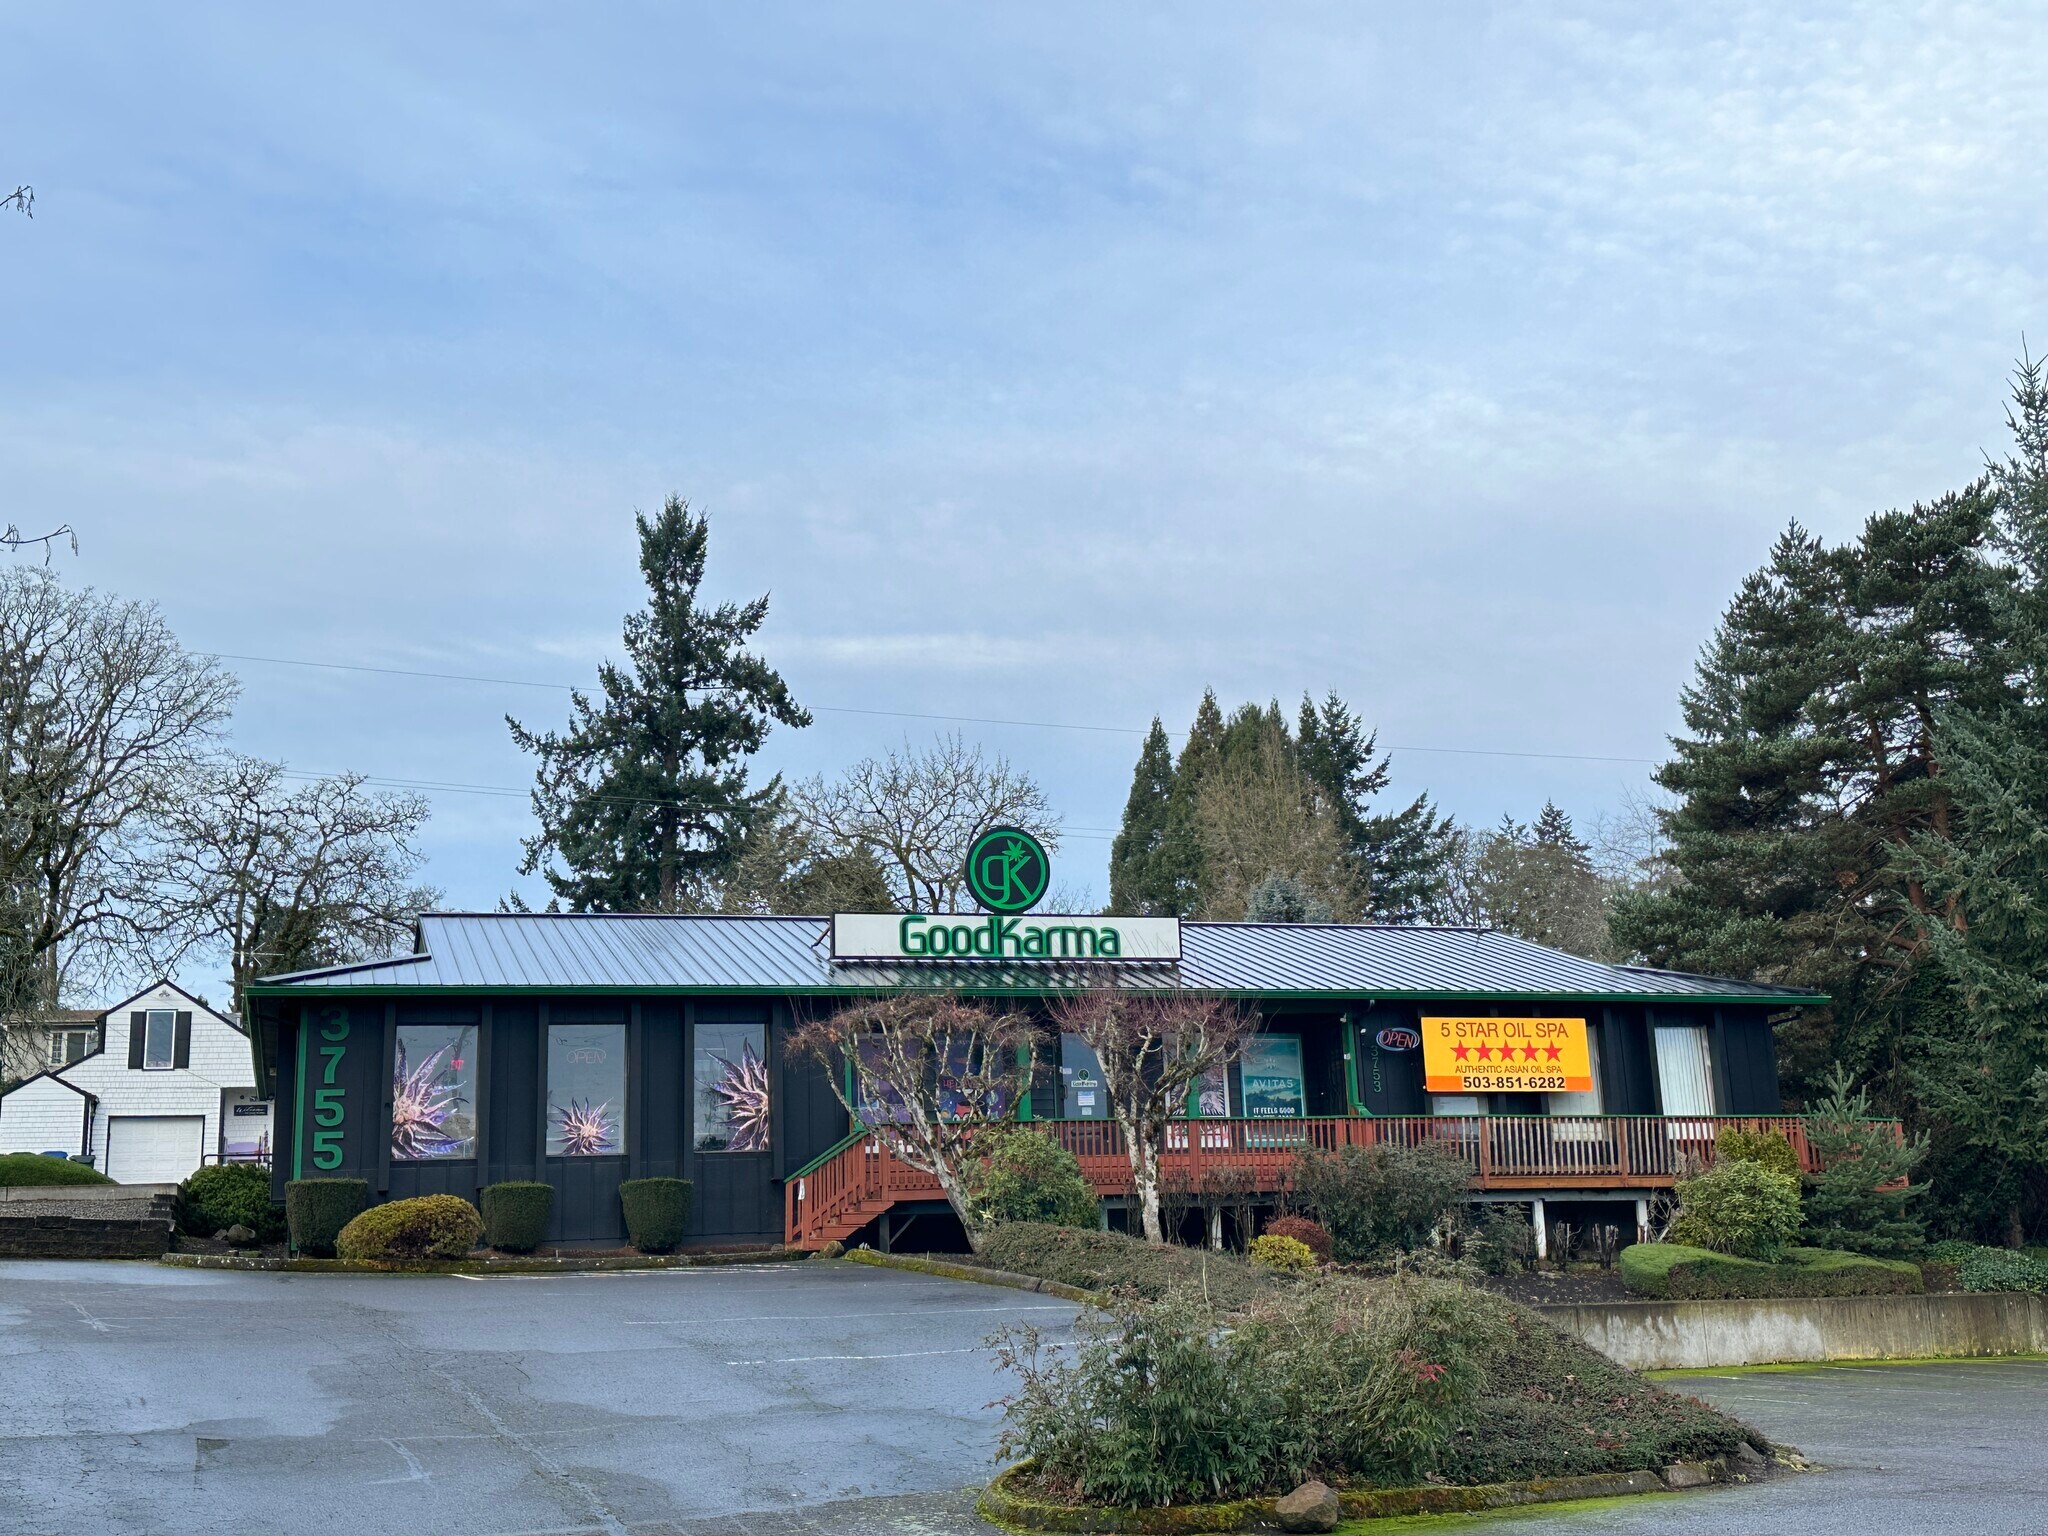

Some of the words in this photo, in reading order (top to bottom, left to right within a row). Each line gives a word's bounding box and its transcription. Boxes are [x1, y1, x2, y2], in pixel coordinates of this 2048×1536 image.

[899, 915, 1121, 957] GoodKarma
[1441, 1022, 1450, 1037] 5
[1455, 1022, 1499, 1037] STAR
[1503, 1022, 1532, 1038] OIL
[1536, 1023, 1569, 1038] SPA
[1381, 1030, 1414, 1048] OPEN
[567, 1050, 604, 1064] OPEN
[1371, 1045, 1381, 1092] 3753
[1455, 1065, 1502, 1073] AUTHENTIC
[1546, 1066, 1562, 1074] SPA
[313, 1006, 350, 1170] 3755
[1253, 1079, 1294, 1088] AVITAS
[1463, 1076, 1565, 1089] 503-851-6282
